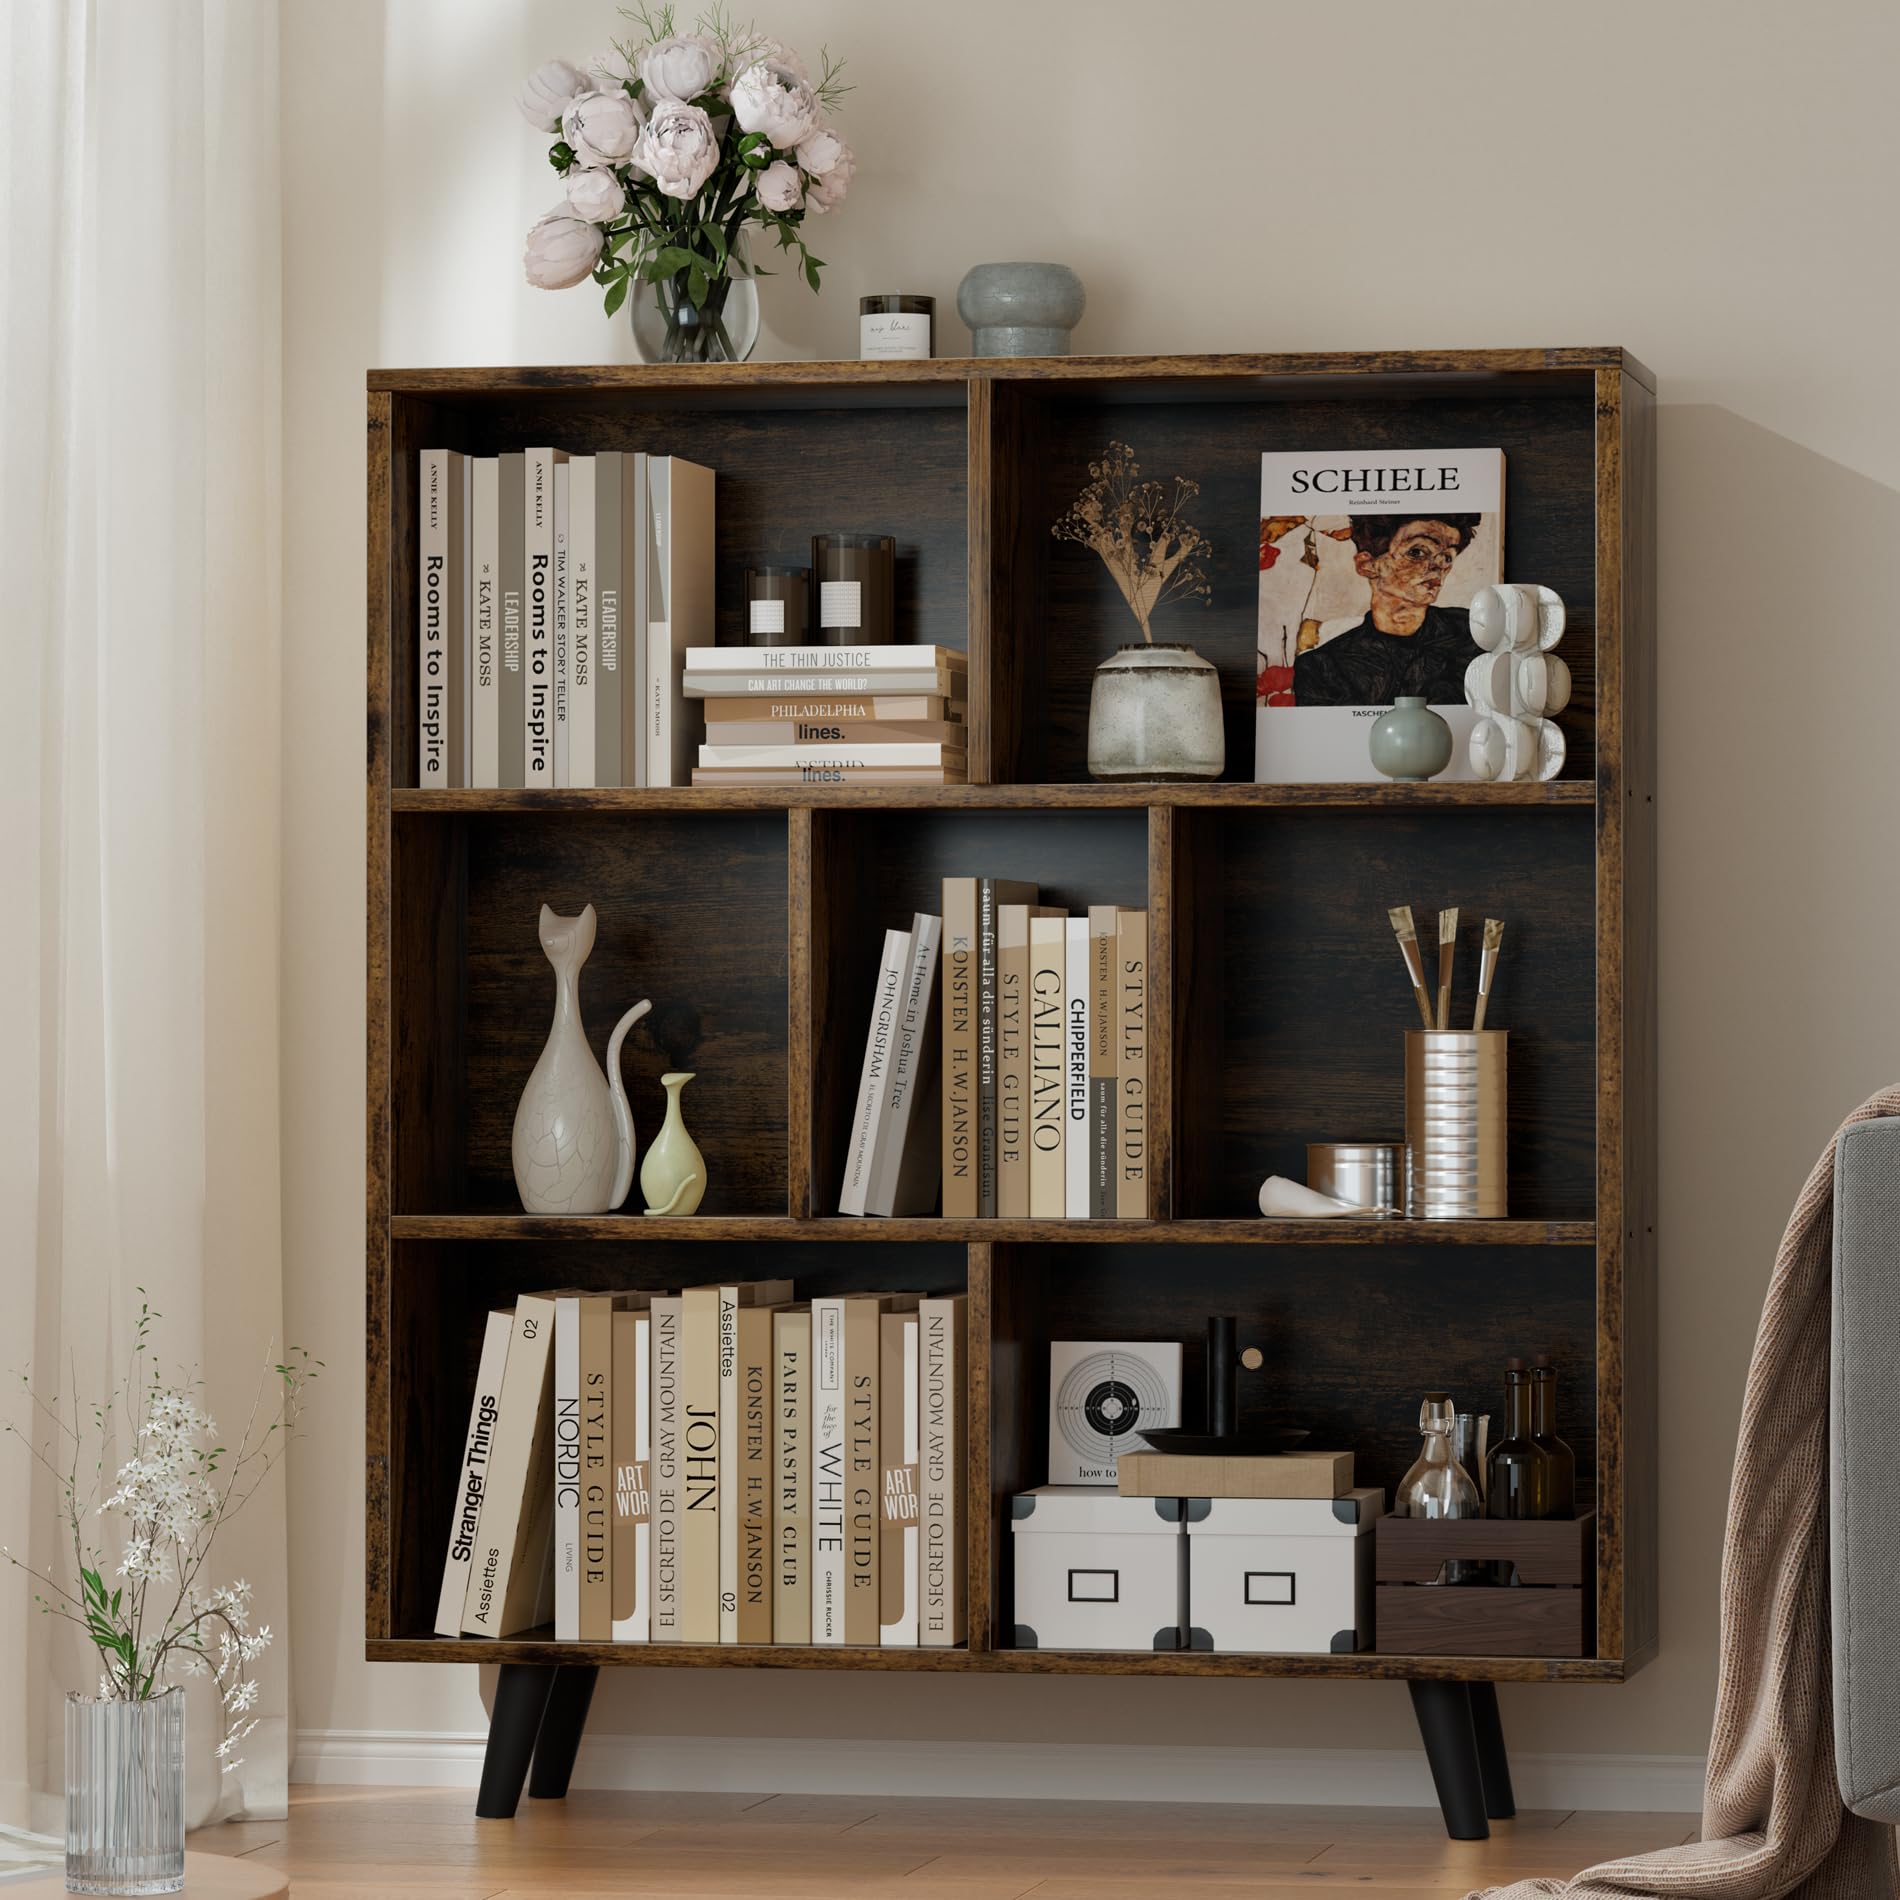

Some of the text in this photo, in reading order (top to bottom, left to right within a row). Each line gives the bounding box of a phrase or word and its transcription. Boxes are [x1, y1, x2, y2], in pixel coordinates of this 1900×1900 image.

[1291, 467, 1460, 493] SCHIELE
[422, 556, 443, 772] Rooms to Inspire
[479, 581, 491, 686] KATE MOSS
[505, 592, 519, 672] LEADERSHIP
[528, 555, 548, 772] Rooms to Inspire
[558, 550, 566, 721] TIM WALKER STORY TELLER
[576, 579, 587, 686] KATE MOSS
[602, 590, 616, 671] LEADERSHIP
[763, 653, 871, 668] THE THIN JUSTICE
[748, 679, 867, 691] CAN ART CHANGE THE WORLD?
[771, 705, 866, 717] PHILADELPHIA
[799, 724, 845, 740] lines.
[802, 768, 845, 782] lines.
[982, 887, 990, 927] saum
[952, 937, 968, 1033] KONSTEN
[982, 932, 994, 961] für
[982, 965, 994, 986] alla
[892, 944, 930, 1110] At Home in Joshua Tree
[982, 990, 994, 1012] die
[982, 1018, 994, 1085] sünderin
[1004, 974, 1018, 1162] STYLE GUIDE
[1033, 970, 1061, 1151] GALLIANO
[1071, 999, 1085, 1121] CHIPPERFIELD
[1126, 961, 1142, 1180] STYLE GUIDE
[865, 1092, 874, 1120] SECRETO
[1100, 1105, 1108, 1118] für
[1100, 1120, 1108, 1134] alla
[1100, 1136, 1108, 1149] die
[853, 1150, 864, 1187] MOUNTAIN
[1100, 1151, 1108, 1187] sünderin
[524, 1319, 538, 1339] 02
[722, 1300, 736, 1377] Assiettes
[748, 1366, 762, 1460] KONSTEN
[453, 1395, 496, 1562] Stranger Things
[558, 1399, 580, 1508] NORDIC
[587, 1374, 604, 1583] STYLE GUIDE
[618, 1464, 644, 1492] ART
[660, 1314, 675, 1626] EL SECRETO DE GRAY MOUNTAIN
[687, 1405, 716, 1512] JOHN
[784, 1352, 797, 1586] PARIS PASTRY CLUB
[854, 1376, 871, 1587] STYLE GUIDE
[886, 1468, 912, 1494] ART
[929, 1316, 944, 1631] EL SECRETO DE GRAY MOUNTAIN
[1079, 1466, 1116, 1478] how to
[819, 1443, 842, 1551] WHITE
[475, 1548, 499, 1624] Assiettes
[722, 1592, 735, 1612] 02
